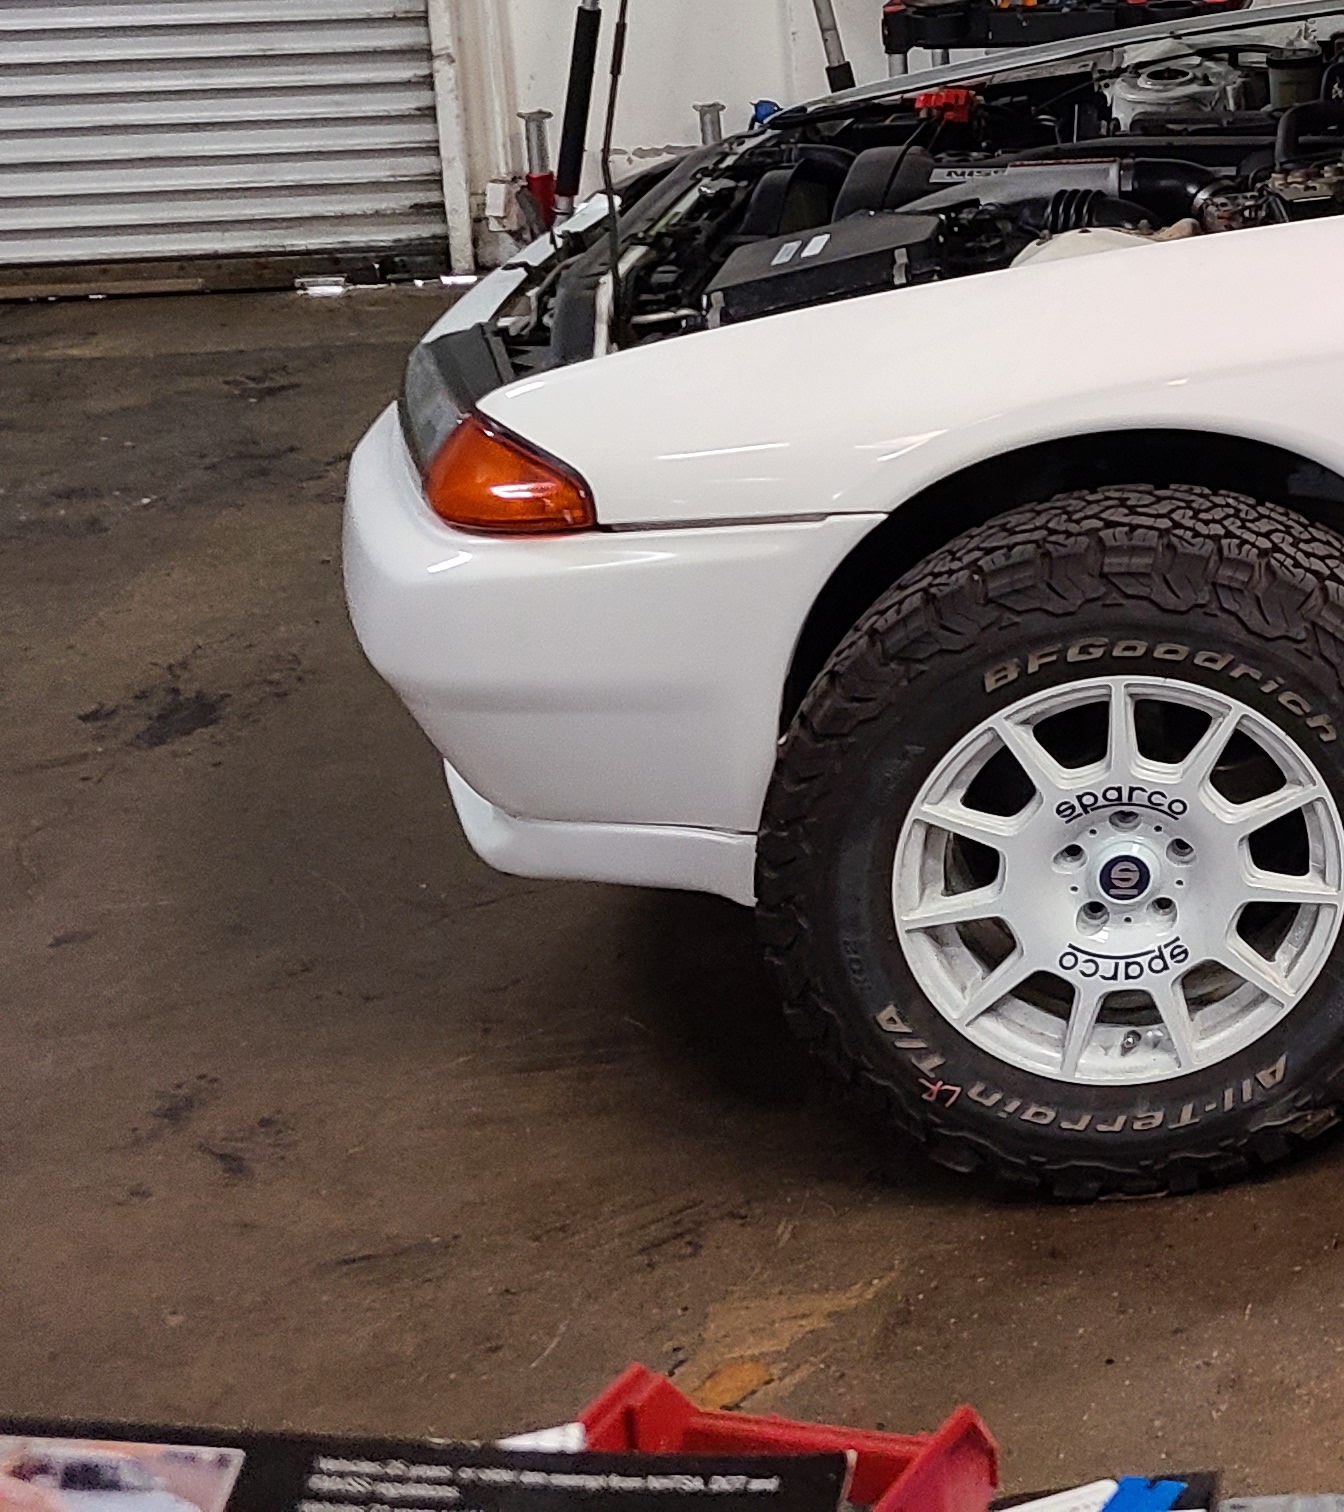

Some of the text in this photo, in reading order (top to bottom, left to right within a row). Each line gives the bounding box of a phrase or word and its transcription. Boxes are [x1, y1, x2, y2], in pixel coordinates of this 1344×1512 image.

[983, 637, 1339, 743] BFGoodrich
[1056, 785, 1188, 822] sparco
[1059, 937, 1189, 981] sparco
[876, 1004, 1287, 1133] All-Terrain T/A
[917, 1076, 963, 1108] LR
